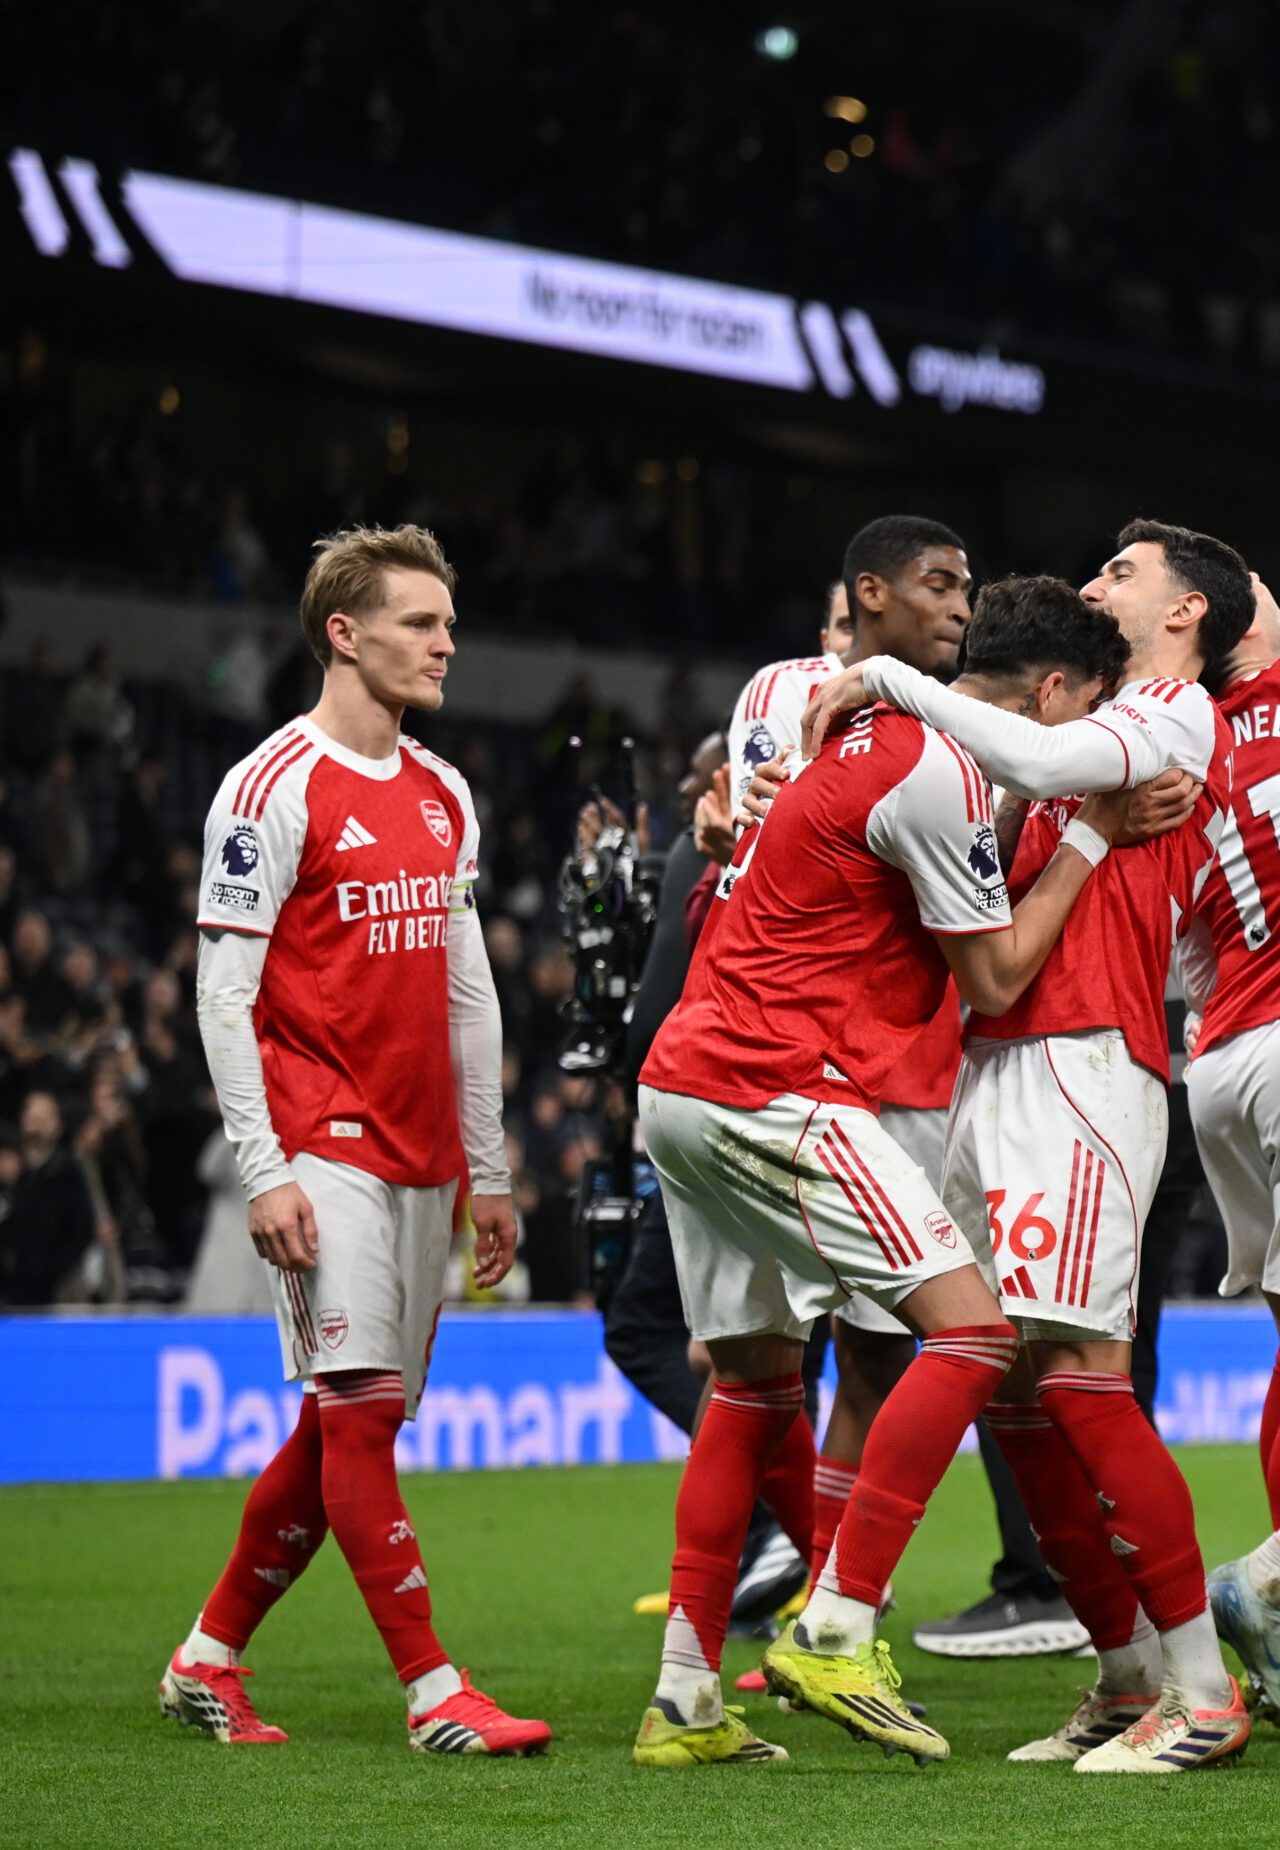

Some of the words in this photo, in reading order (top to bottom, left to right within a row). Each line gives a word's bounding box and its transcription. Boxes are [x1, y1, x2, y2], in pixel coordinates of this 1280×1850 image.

[209, 882, 223, 895] No
[224, 886, 255, 901] room
[974, 889, 988, 900] No
[368, 918, 400, 956] FLY
[985, 1189, 1057, 1261] 36
